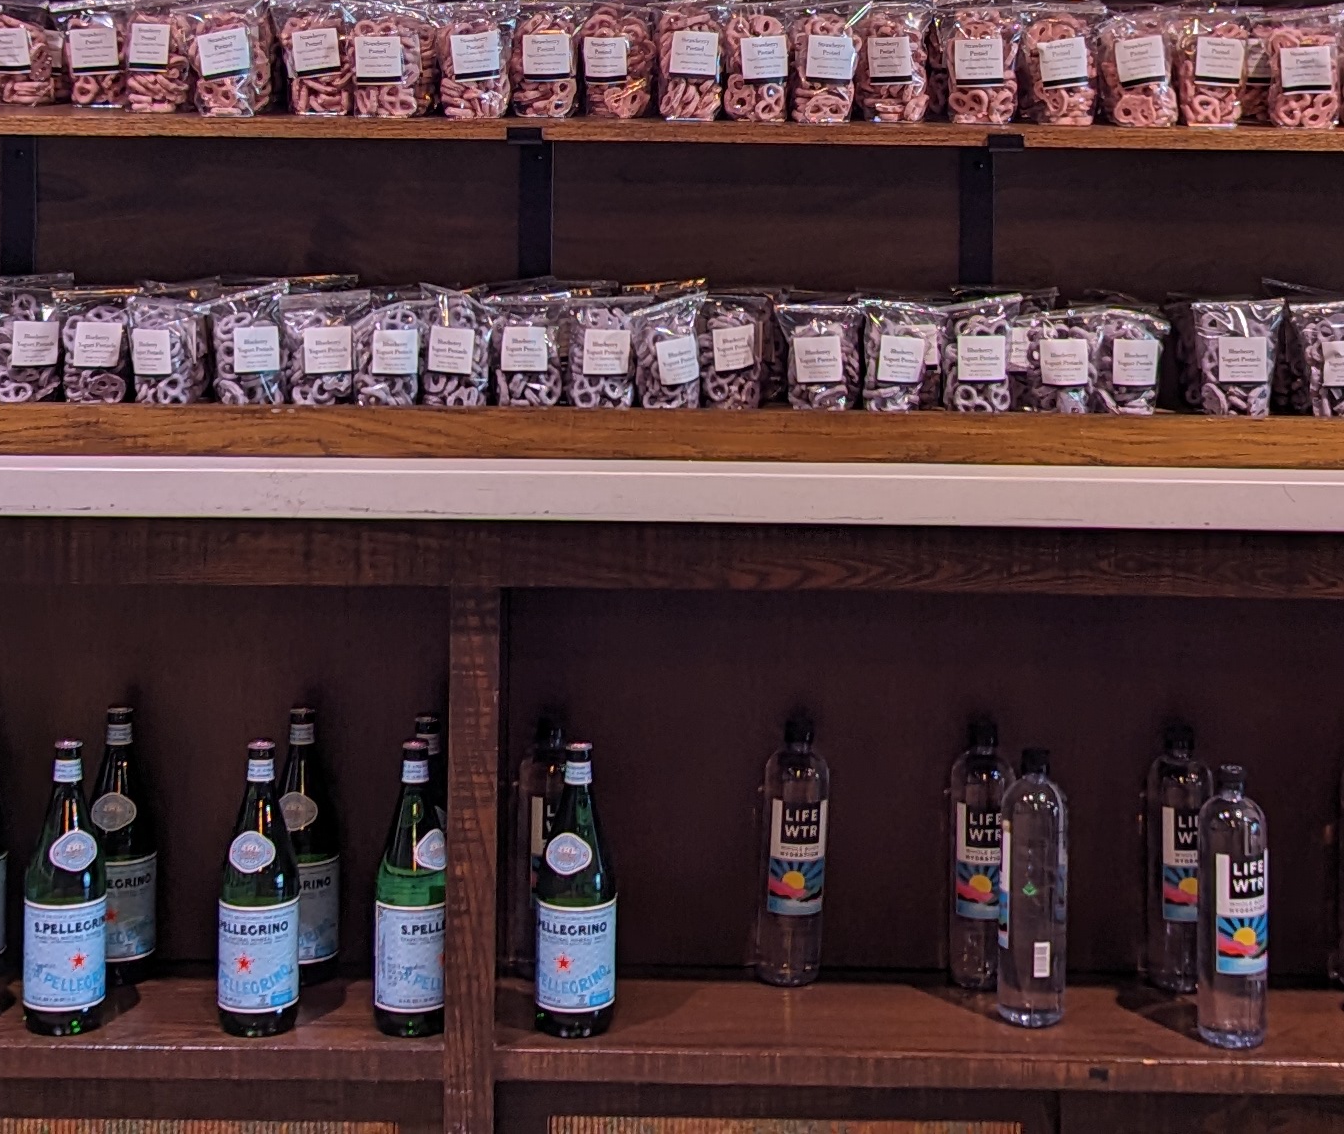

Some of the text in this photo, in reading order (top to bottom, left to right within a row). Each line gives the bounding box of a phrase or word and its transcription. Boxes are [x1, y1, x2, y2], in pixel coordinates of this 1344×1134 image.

[786, 809, 818, 822] LIFE
[785, 825, 817, 838] WTR
[1233, 859, 1264, 876] LIFE
[106, 873, 151, 889] EGRINO
[1232, 876, 1264, 893] WTR
